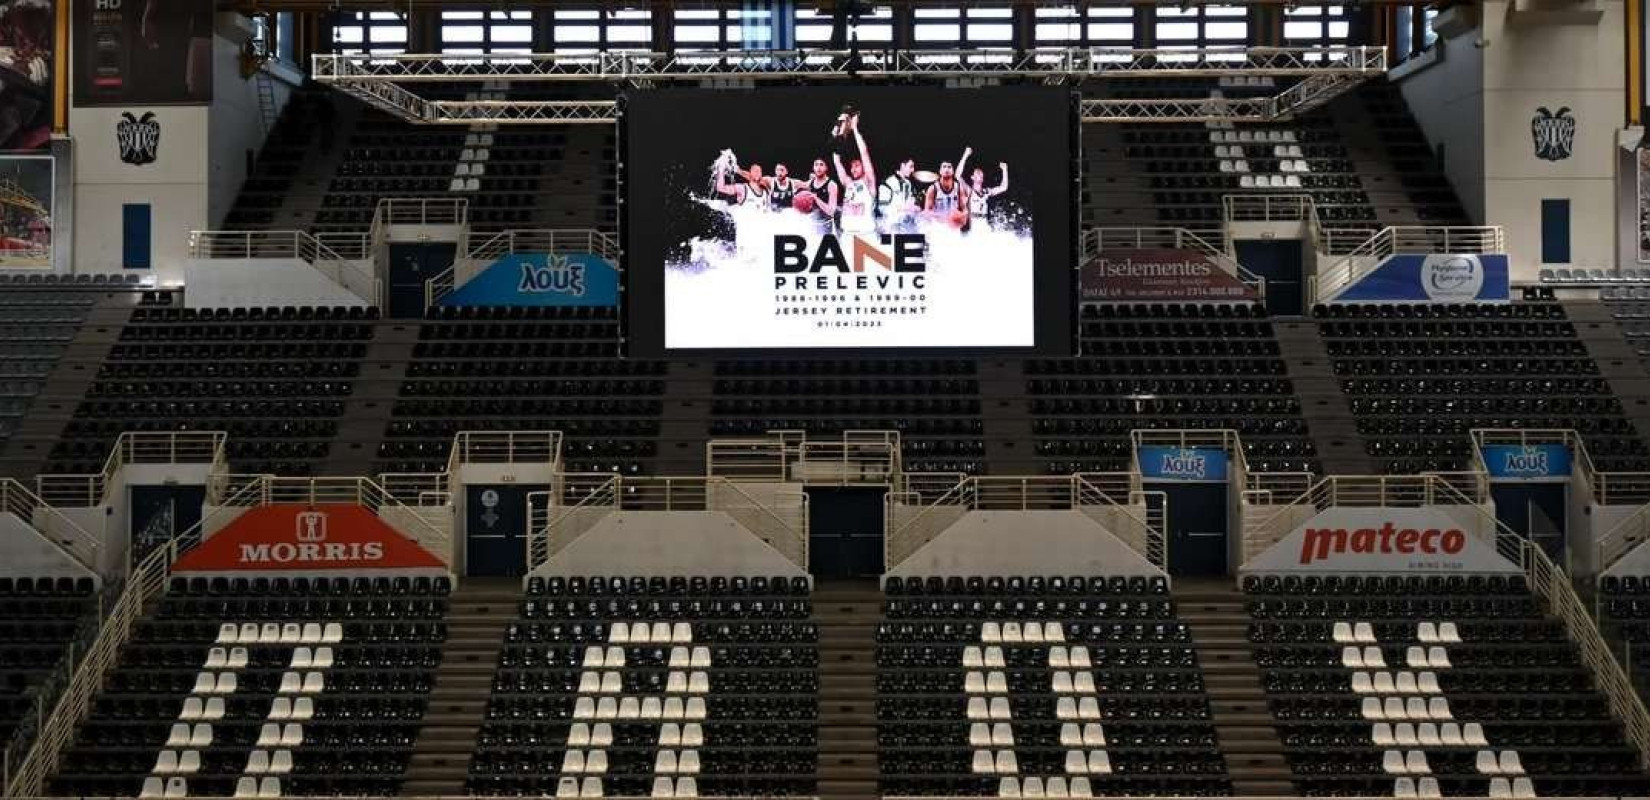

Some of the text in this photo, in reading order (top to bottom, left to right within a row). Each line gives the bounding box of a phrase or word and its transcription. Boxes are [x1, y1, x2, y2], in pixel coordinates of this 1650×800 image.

[773, 234, 926, 273] BANE
[1095, 257, 1212, 277] Tselementes
[774, 275, 926, 290] PRELEVIC
[775, 307, 927, 315] JERSEY RETIREMENT
[239, 542, 384, 562] MORRIS
[1300, 522, 1466, 564] mateco
